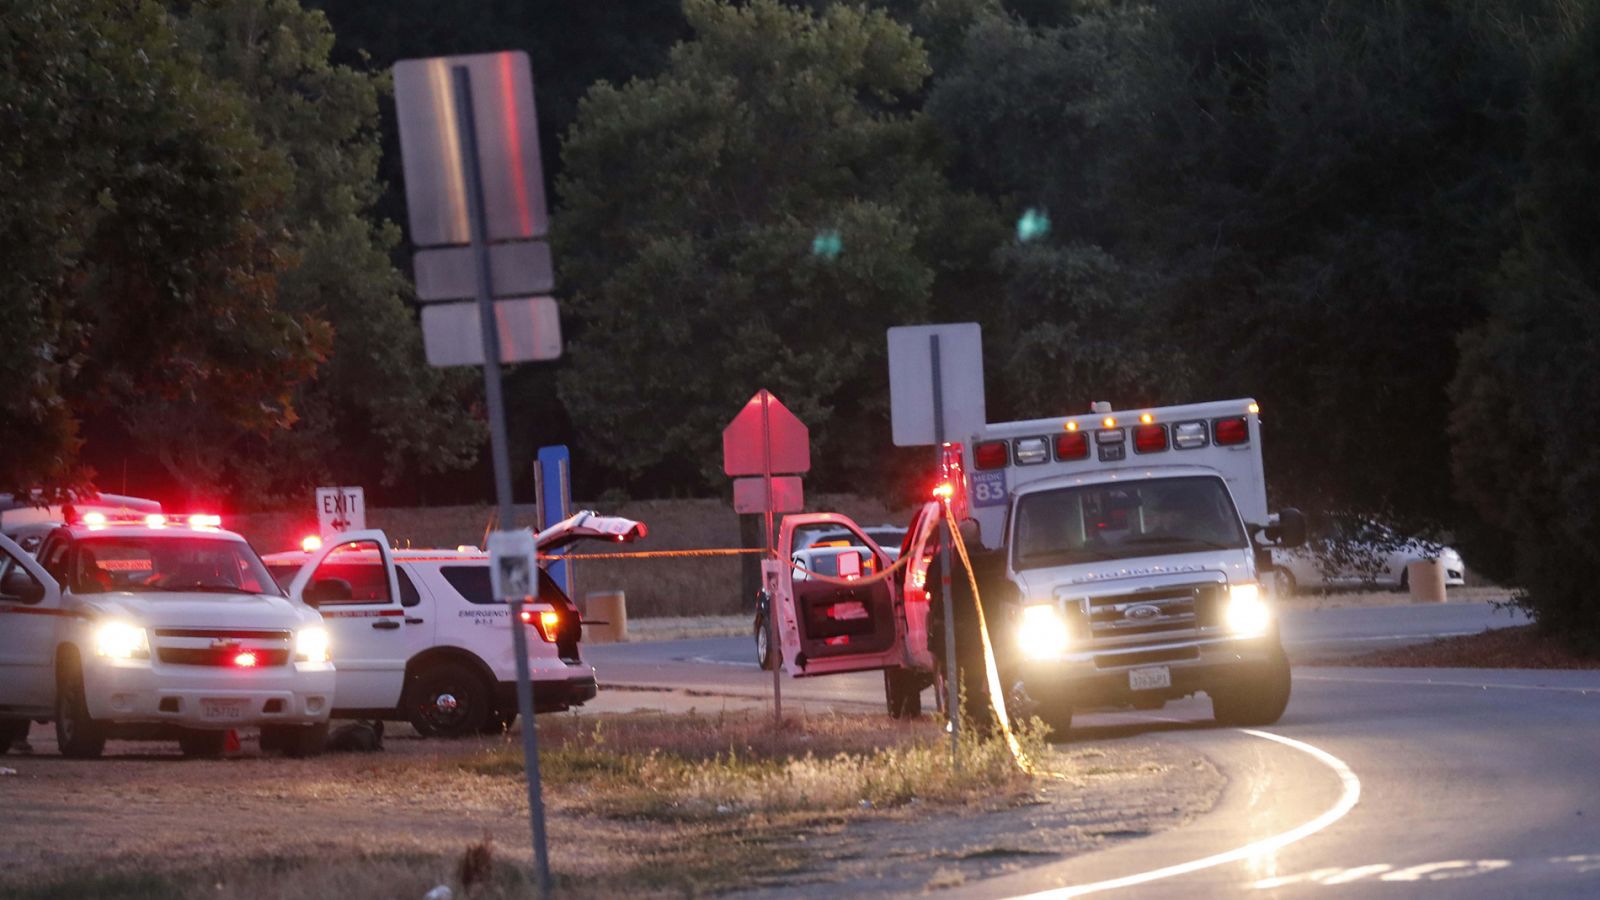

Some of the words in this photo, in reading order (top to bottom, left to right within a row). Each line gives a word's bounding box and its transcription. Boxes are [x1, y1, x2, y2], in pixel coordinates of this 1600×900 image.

[973, 472, 1001, 481] MEDIC
[976, 482, 1004, 501] 83
[323, 494, 357, 514] EXIT
